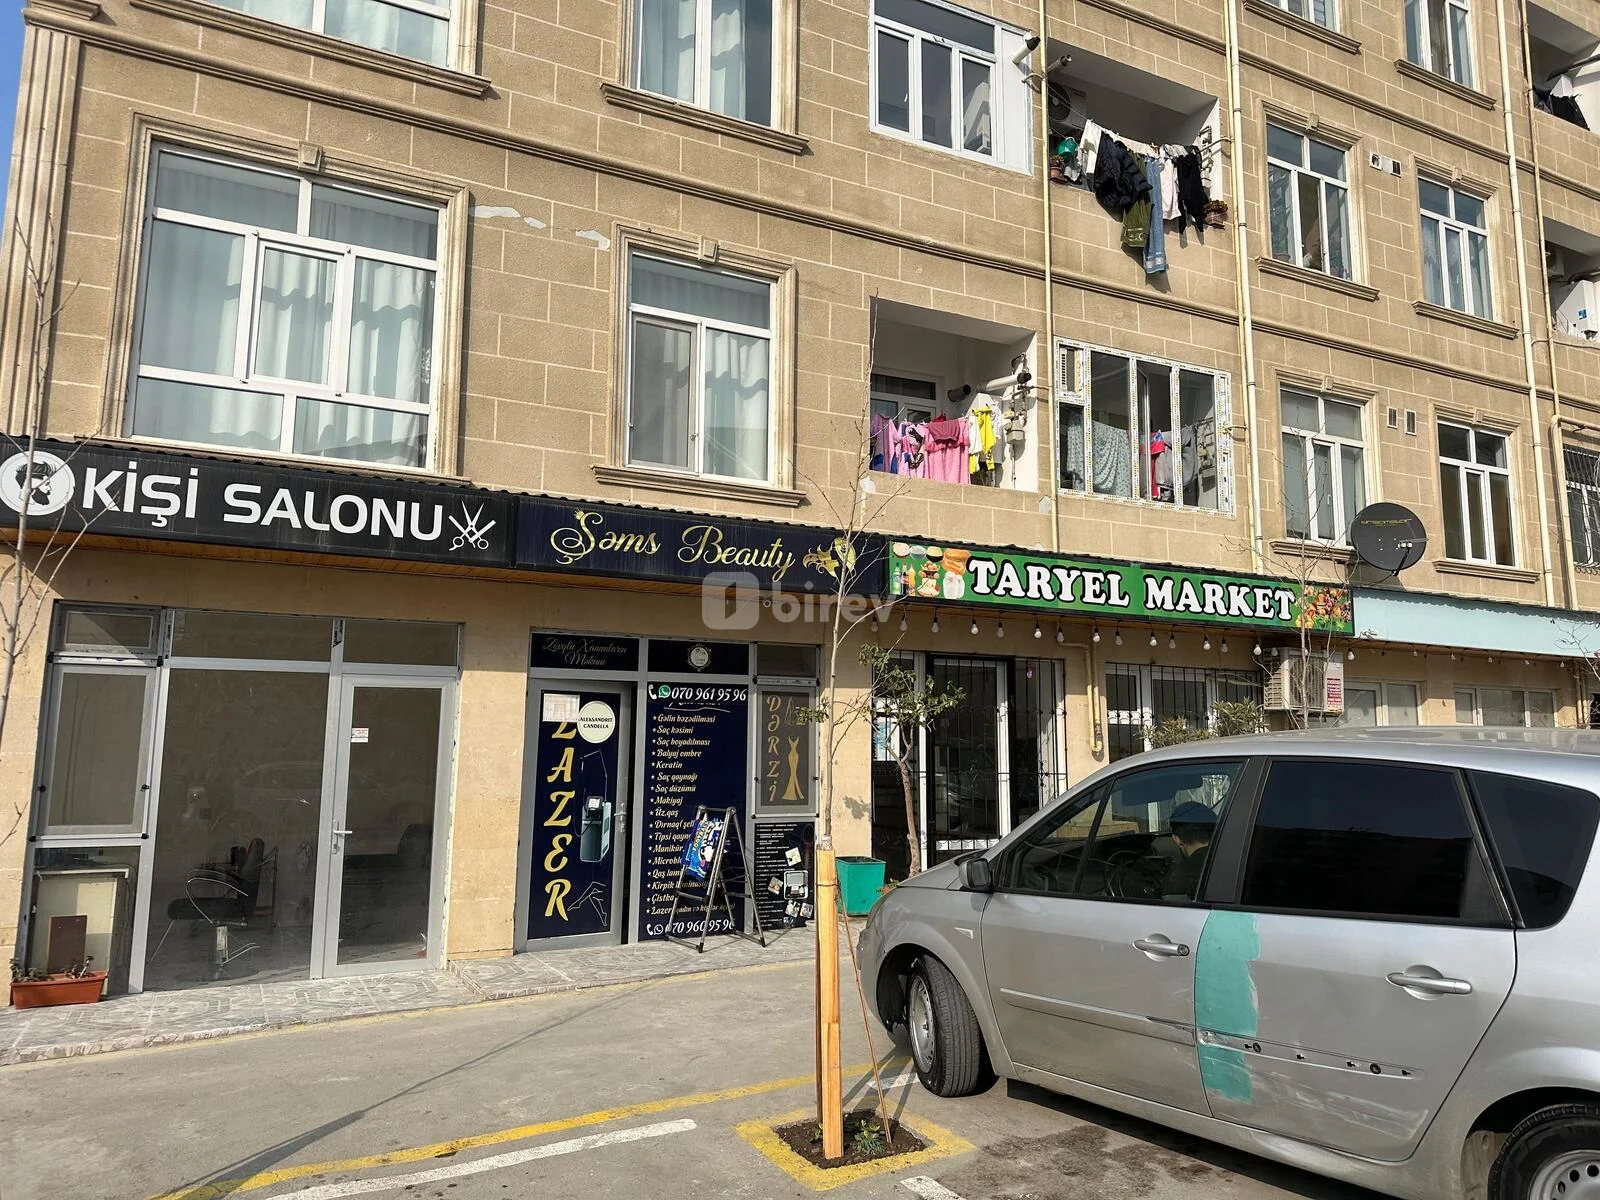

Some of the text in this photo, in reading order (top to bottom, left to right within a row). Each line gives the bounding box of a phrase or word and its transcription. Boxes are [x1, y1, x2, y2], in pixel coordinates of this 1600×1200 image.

[82, 461, 443, 541] KİŞİ SALONU
[677, 525, 796, 582] Beauty
[968, 558, 1296, 621] TARYEL MARKET
[671, 687, 747, 701] 070 961 95 96
[657, 713, 676, 723] Gəlin
[656, 725, 694, 735] Saç kəsimi
[656, 737, 669, 747] Saç
[766, 695, 781, 802] DƏRZİ
[656, 761, 683, 769] Keratin
[657, 772, 670, 781] Saç
[655, 784, 668, 794] Saç
[654, 796, 684, 806] Makiyaj
[652, 868, 666, 878] Qaş
[651, 882, 674, 891] Kirpik
[665, 921, 685, 934] 70
[708, 919, 722, 932] 95
